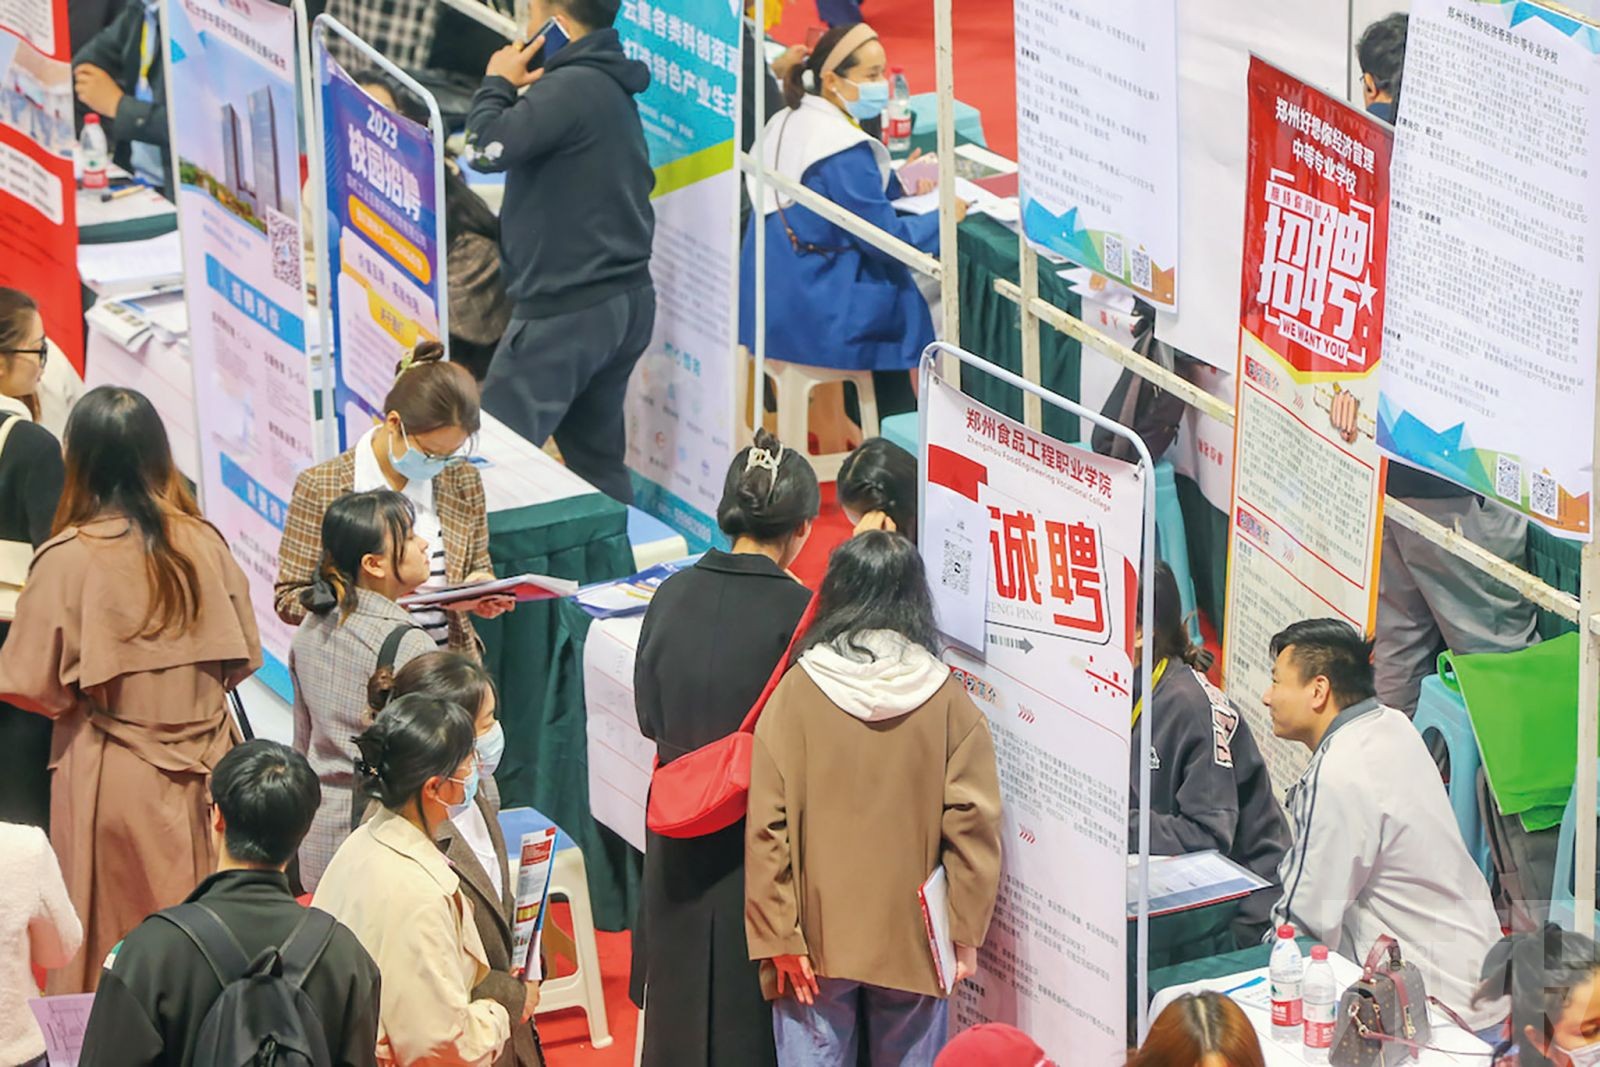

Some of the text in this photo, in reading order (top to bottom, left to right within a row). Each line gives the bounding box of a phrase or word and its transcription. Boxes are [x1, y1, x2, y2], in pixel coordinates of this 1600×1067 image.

[366, 104, 399, 150] 2023
[1275, 95, 1376, 174] 郑州好想你经济管理
[1291, 137, 1358, 197] 中等专业学校
[347, 123, 422, 222] 校园招聘
[1256, 201, 1370, 341] 招聘
[1281, 318, 1347, 360] WE WANT YOU
[965, 406, 1113, 500] 郑州食品工程职业学院
[986, 504, 1106, 634] 诚聘
